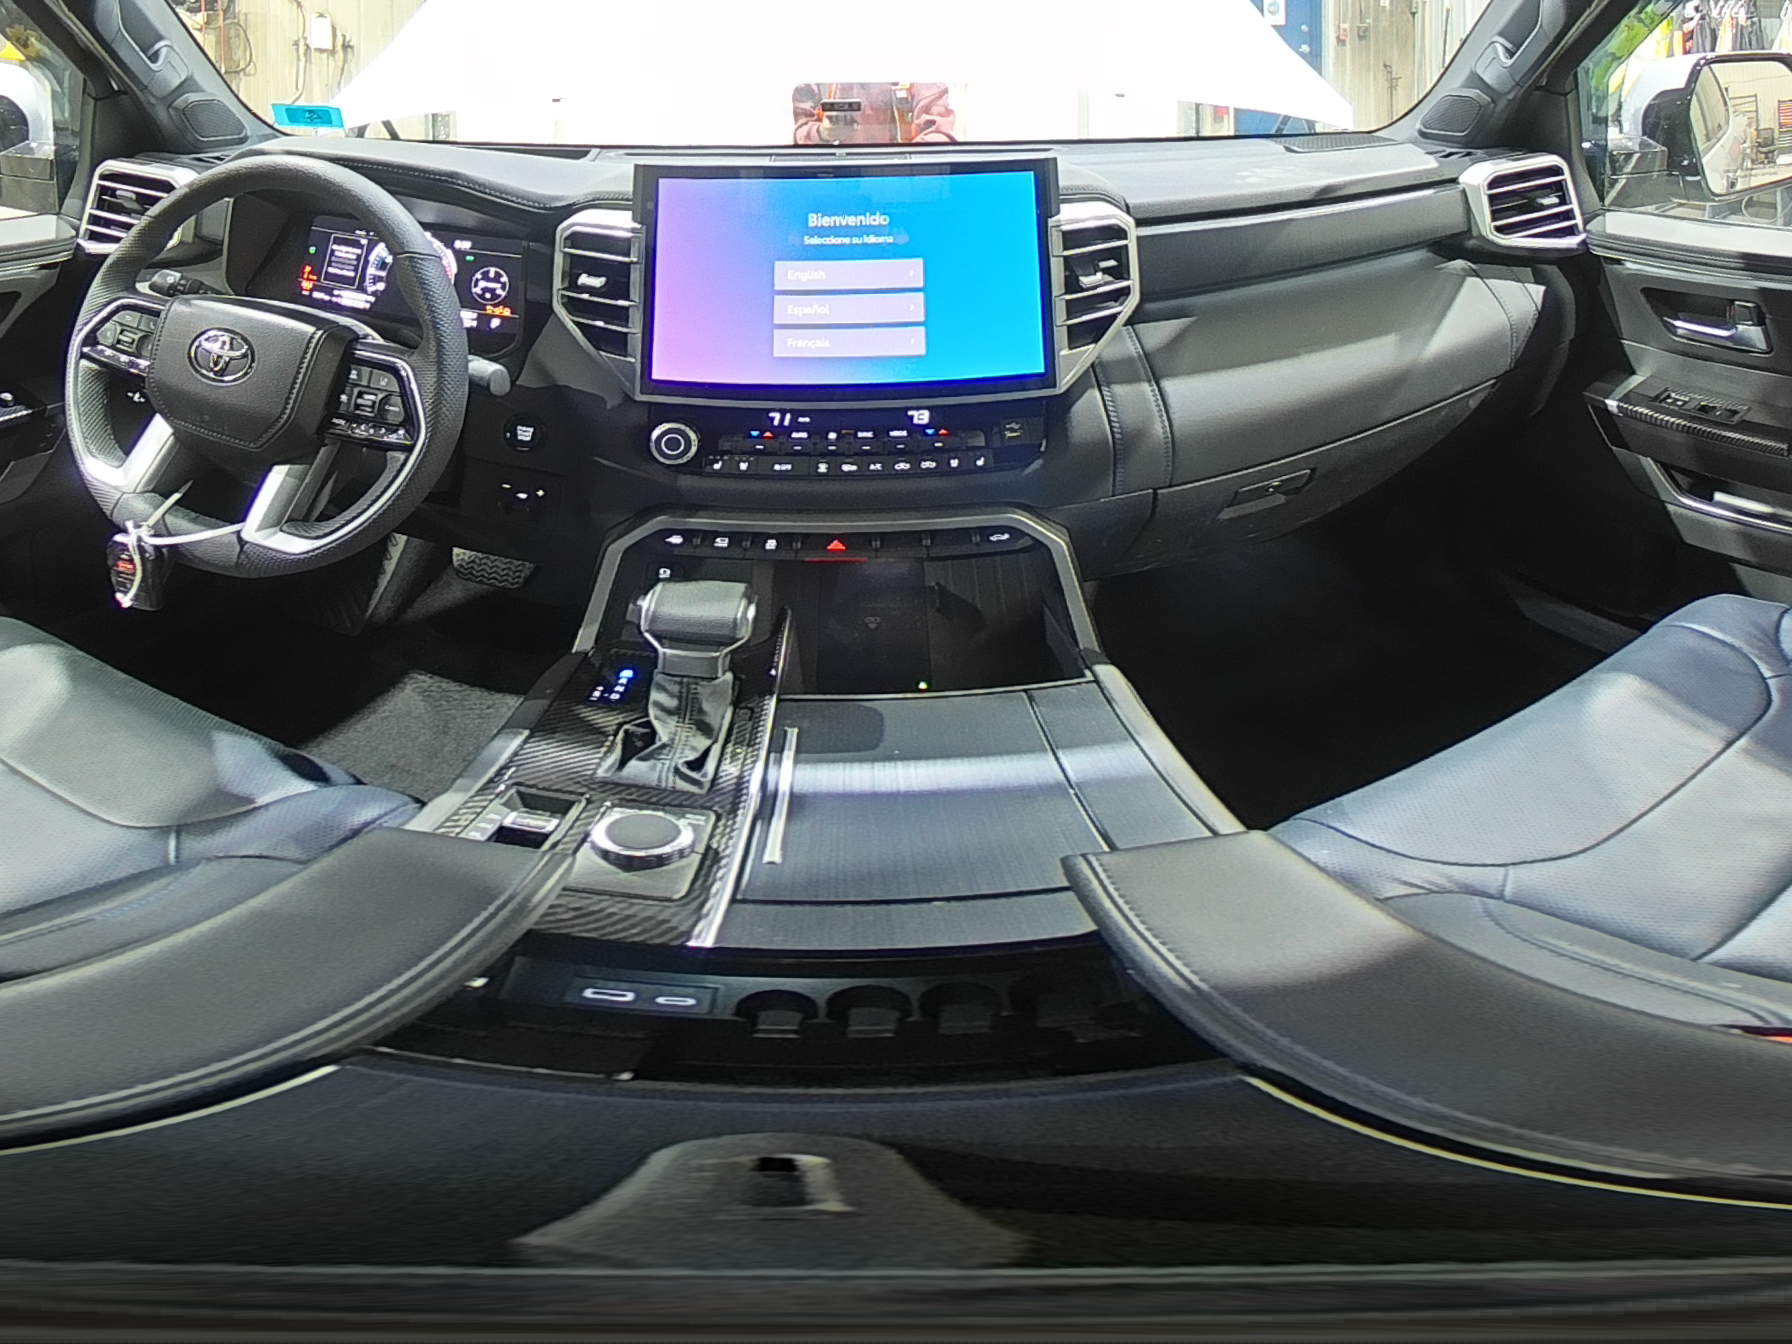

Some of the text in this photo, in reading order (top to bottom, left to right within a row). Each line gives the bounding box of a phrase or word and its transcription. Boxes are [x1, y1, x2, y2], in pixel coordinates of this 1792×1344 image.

[807, 211, 891, 228] Bienvenido
[787, 269, 827, 283] English
[787, 303, 830, 317] Español
[787, 337, 831, 350] Français
[768, 411, 792, 427] 71
[907, 409, 931, 425] 73
